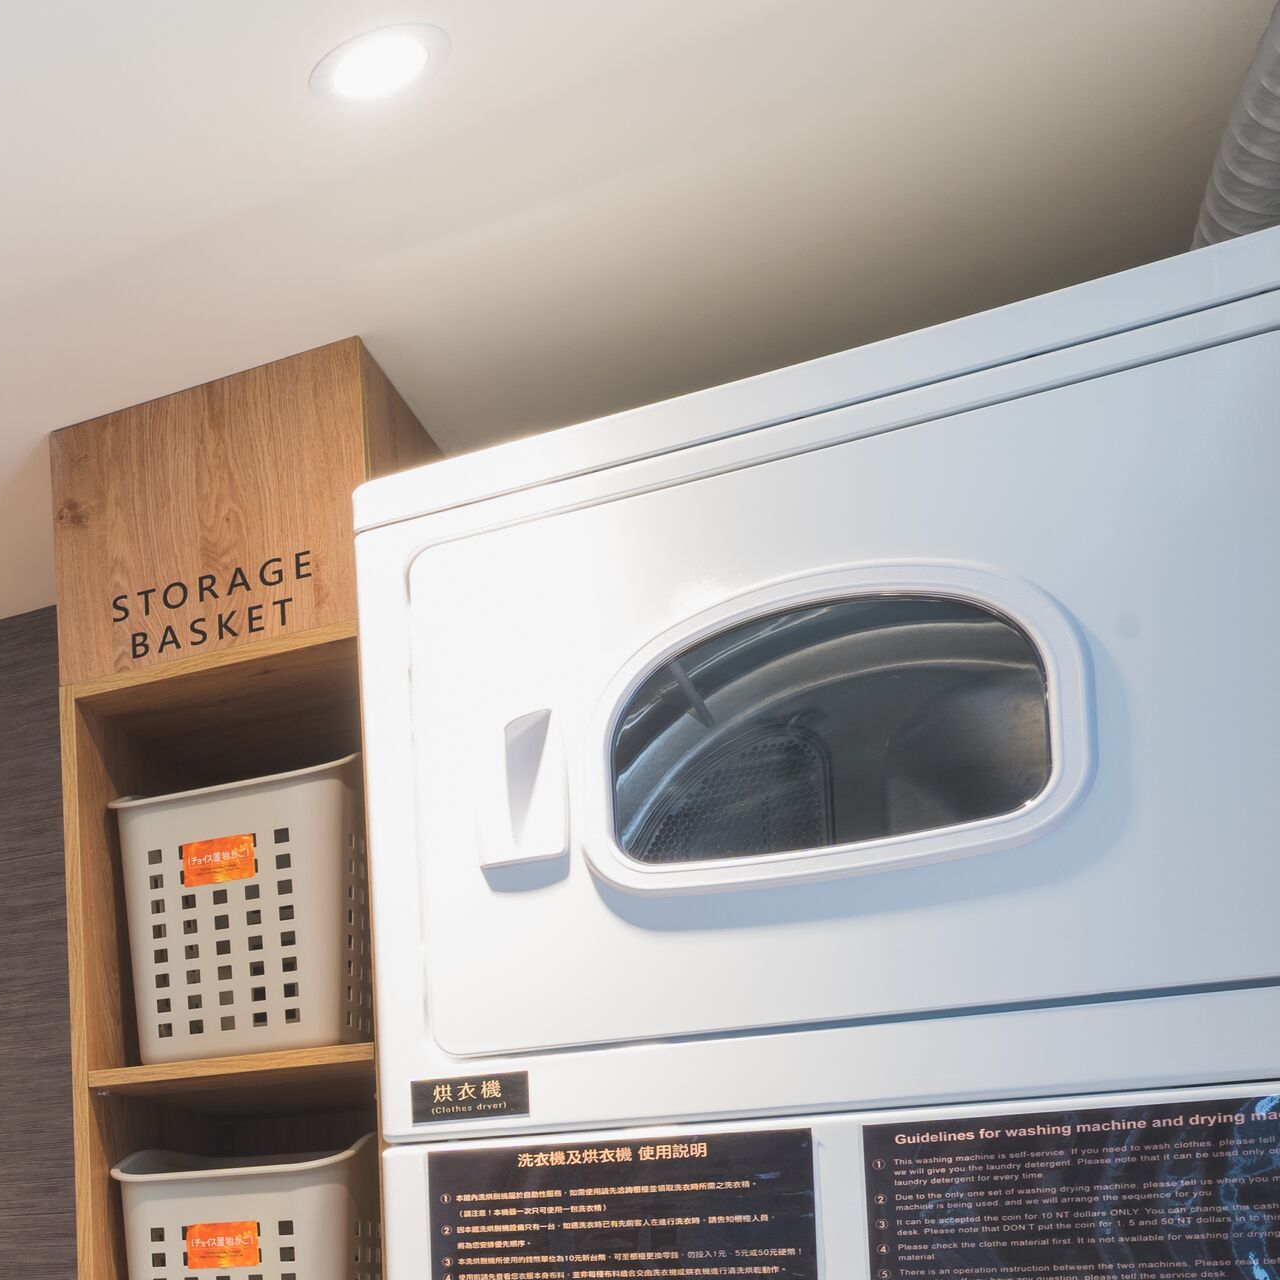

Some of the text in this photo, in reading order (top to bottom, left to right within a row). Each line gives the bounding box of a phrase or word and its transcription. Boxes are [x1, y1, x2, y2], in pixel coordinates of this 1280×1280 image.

[111, 550, 312, 623] STORAGE
[131, 597, 293, 659] BASKET
[433, 1080, 502, 1103] 烘衣機
[894, 1111, 1280, 1144] Guidelines for washing machine and drying ma
[517, 1146, 633, 1168] 洗衣機及烘衣機
